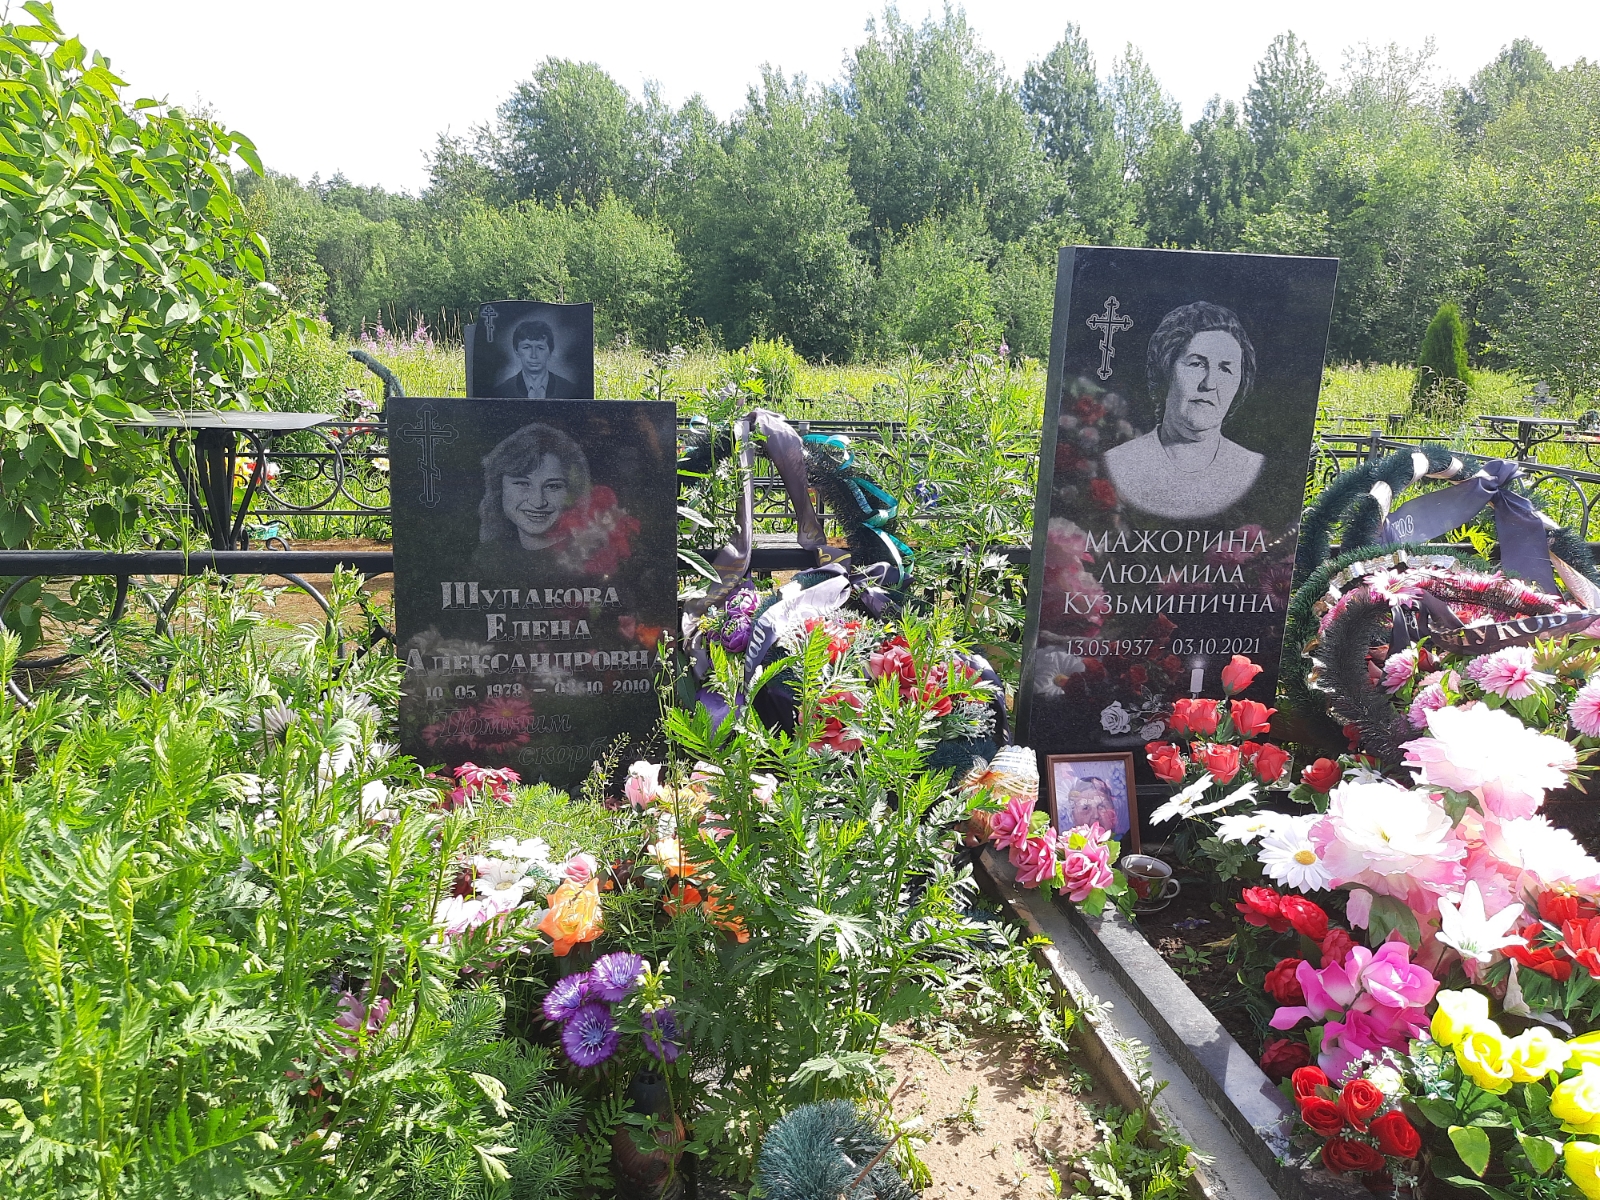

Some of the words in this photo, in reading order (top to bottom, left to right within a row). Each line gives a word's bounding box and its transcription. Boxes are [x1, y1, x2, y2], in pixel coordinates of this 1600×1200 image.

[1084, 530, 1268, 553] МАЖОРИНА
[1098, 561, 1245, 585] ЛЮДМИЛА
[440, 581, 622, 611] ШУЛАКОВА
[1063, 591, 1275, 615] КУЗЬМИНИЧНА
[486, 613, 592, 643] ЕЛЕНА
[1066, 639, 1153, 656] 13.05.1937
[1172, 637, 1261, 655] 03.10.2021
[454, 685, 477, 699] 05
[486, 683, 523, 698] 1978
[587, 681, 603, 695] 10
[612, 679, 650, 695] 2010
[433, 708, 572, 738] Помним
[518, 736, 642, 772] скорб
